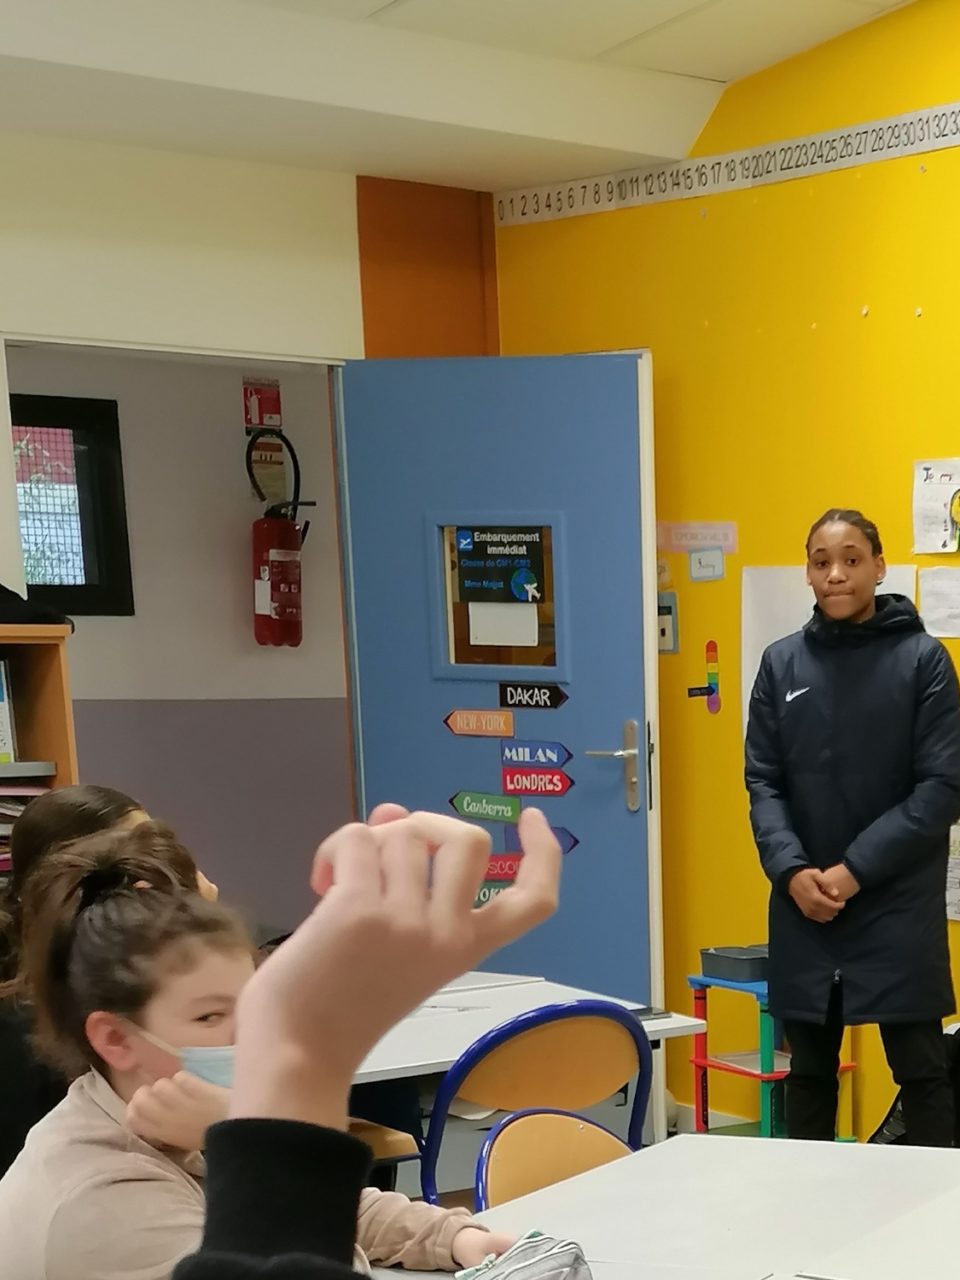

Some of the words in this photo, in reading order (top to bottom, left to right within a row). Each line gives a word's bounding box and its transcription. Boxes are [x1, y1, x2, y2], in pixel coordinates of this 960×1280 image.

[498, 200, 504, 221] 0
[510, 198, 514, 216] 1
[521, 195, 527, 216] 2
[533, 193, 539, 214] 3
[545, 192, 551, 212] 4
[556, 191, 563, 212] 5
[568, 187, 574, 208] 6
[581, 185, 587, 206] 7
[593, 183, 600, 204] 8
[607, 181, 613, 202] 9
[617, 179, 627, 201] 10
[629, 176, 639, 197] 11
[643, 173, 654, 195] 12
[657, 171, 667, 193] 13
[670, 170, 681, 191] 14
[682, 168, 693, 190] 15
[695, 164, 708, 186] 16
[710, 162, 721, 184] 17
[725, 159, 736, 181] 18
[739, 157, 750, 179] 19
[751, 154, 764, 179] 20
[764, 150, 777, 174] 21
[779, 146, 794, 171] 22
[795, 144, 808, 168] 23
[810, 140, 824, 165] 24
[824, 139, 838, 164] 25
[839, 134, 853, 158] 26
[855, 131, 868, 156] 27
[871, 128, 884, 152] 28
[887, 124, 900, 148] 29
[902, 121, 915, 147] 30
[917, 117, 931, 141] 31
[933, 113, 949, 139] 32
[473, 531, 540, 543] Embarquement
[506, 686, 551, 706] DAKAR
[503, 747, 558, 763] MILAN
[506, 774, 562, 791] LONDRES
[463, 796, 513, 817] Canberra
